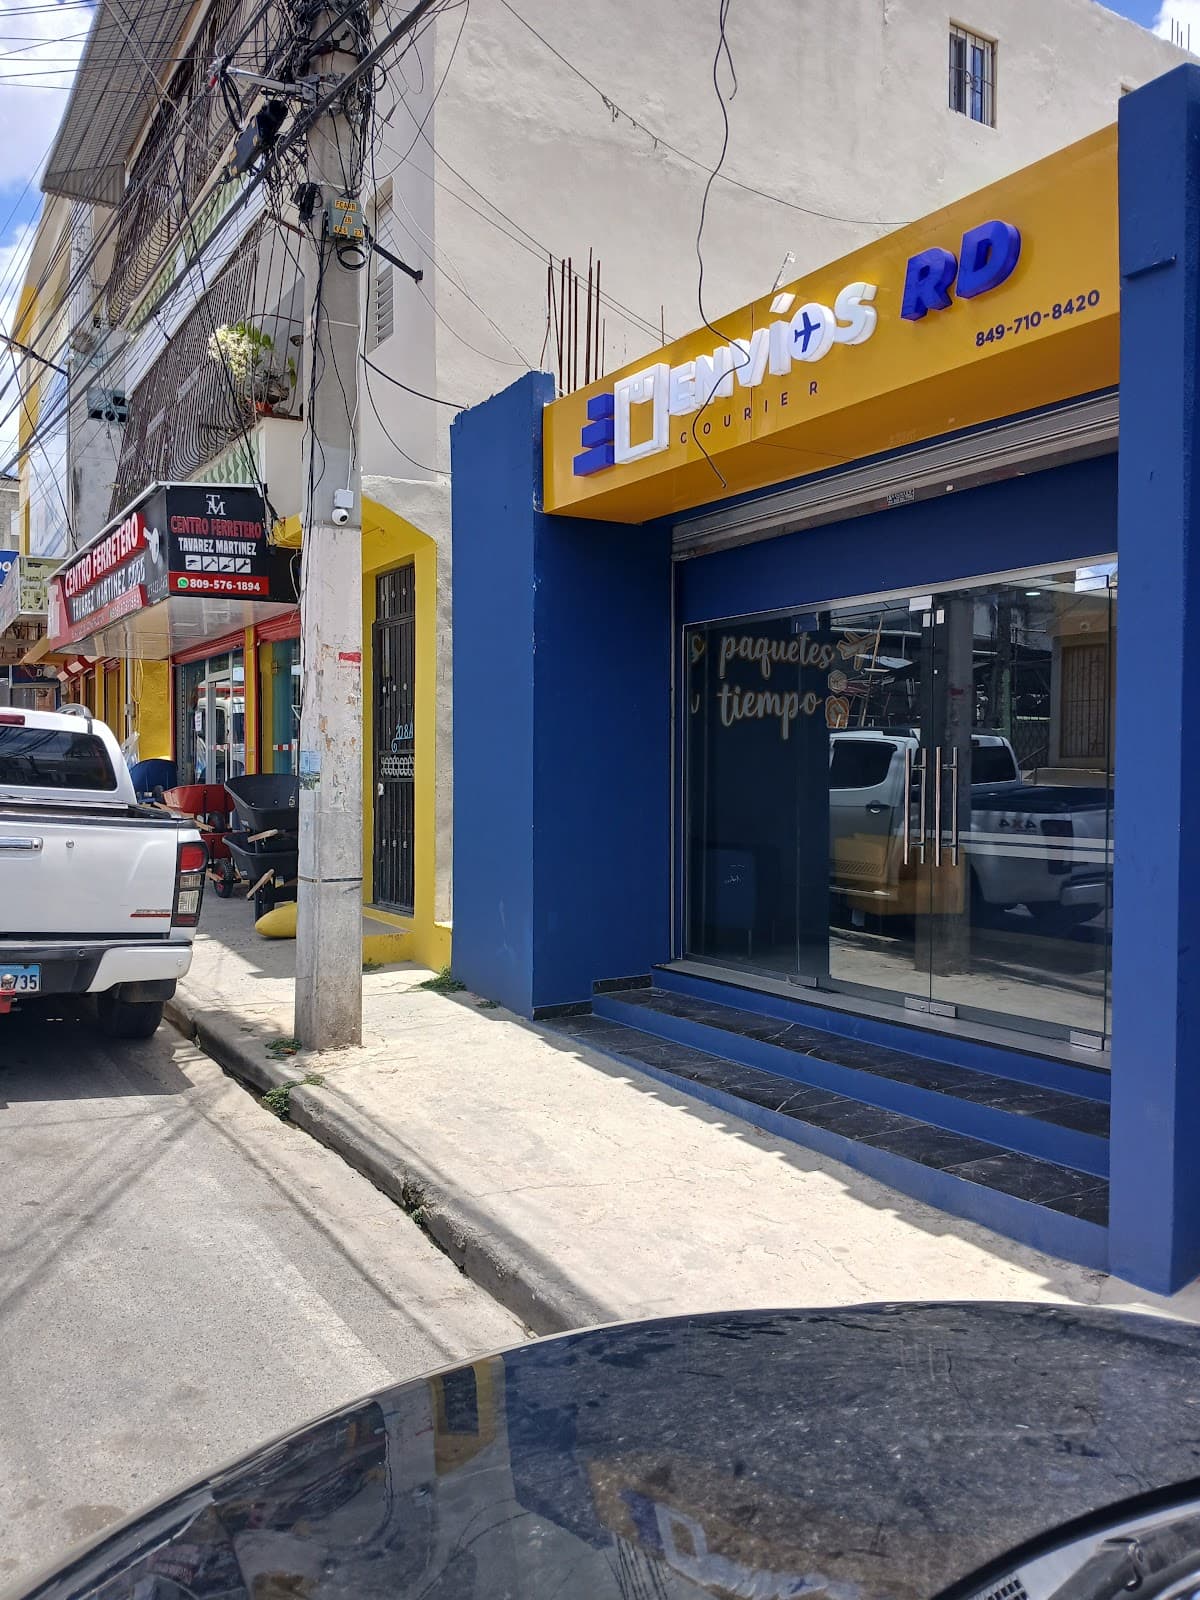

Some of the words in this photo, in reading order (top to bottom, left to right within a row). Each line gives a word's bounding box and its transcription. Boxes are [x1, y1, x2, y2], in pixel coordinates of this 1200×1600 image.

[900, 219, 1022, 321] RD
[975, 289, 1101, 347] 849-710-8420
[680, 381, 818, 444] COURIER
[65, 553, 92, 598] CENTRO
[92, 511, 139, 579] FERRETERO
[170, 515, 209, 535] CENTRO
[211, 518, 262, 538] FERRETERO
[178, 537, 215, 553] TAVAREZ
[215, 539, 257, 556] MARTINEZ
[189, 578, 261, 592] 809-576-1894
[719, 631, 835, 680] paquetes
[717, 683, 824, 740] tiempo
